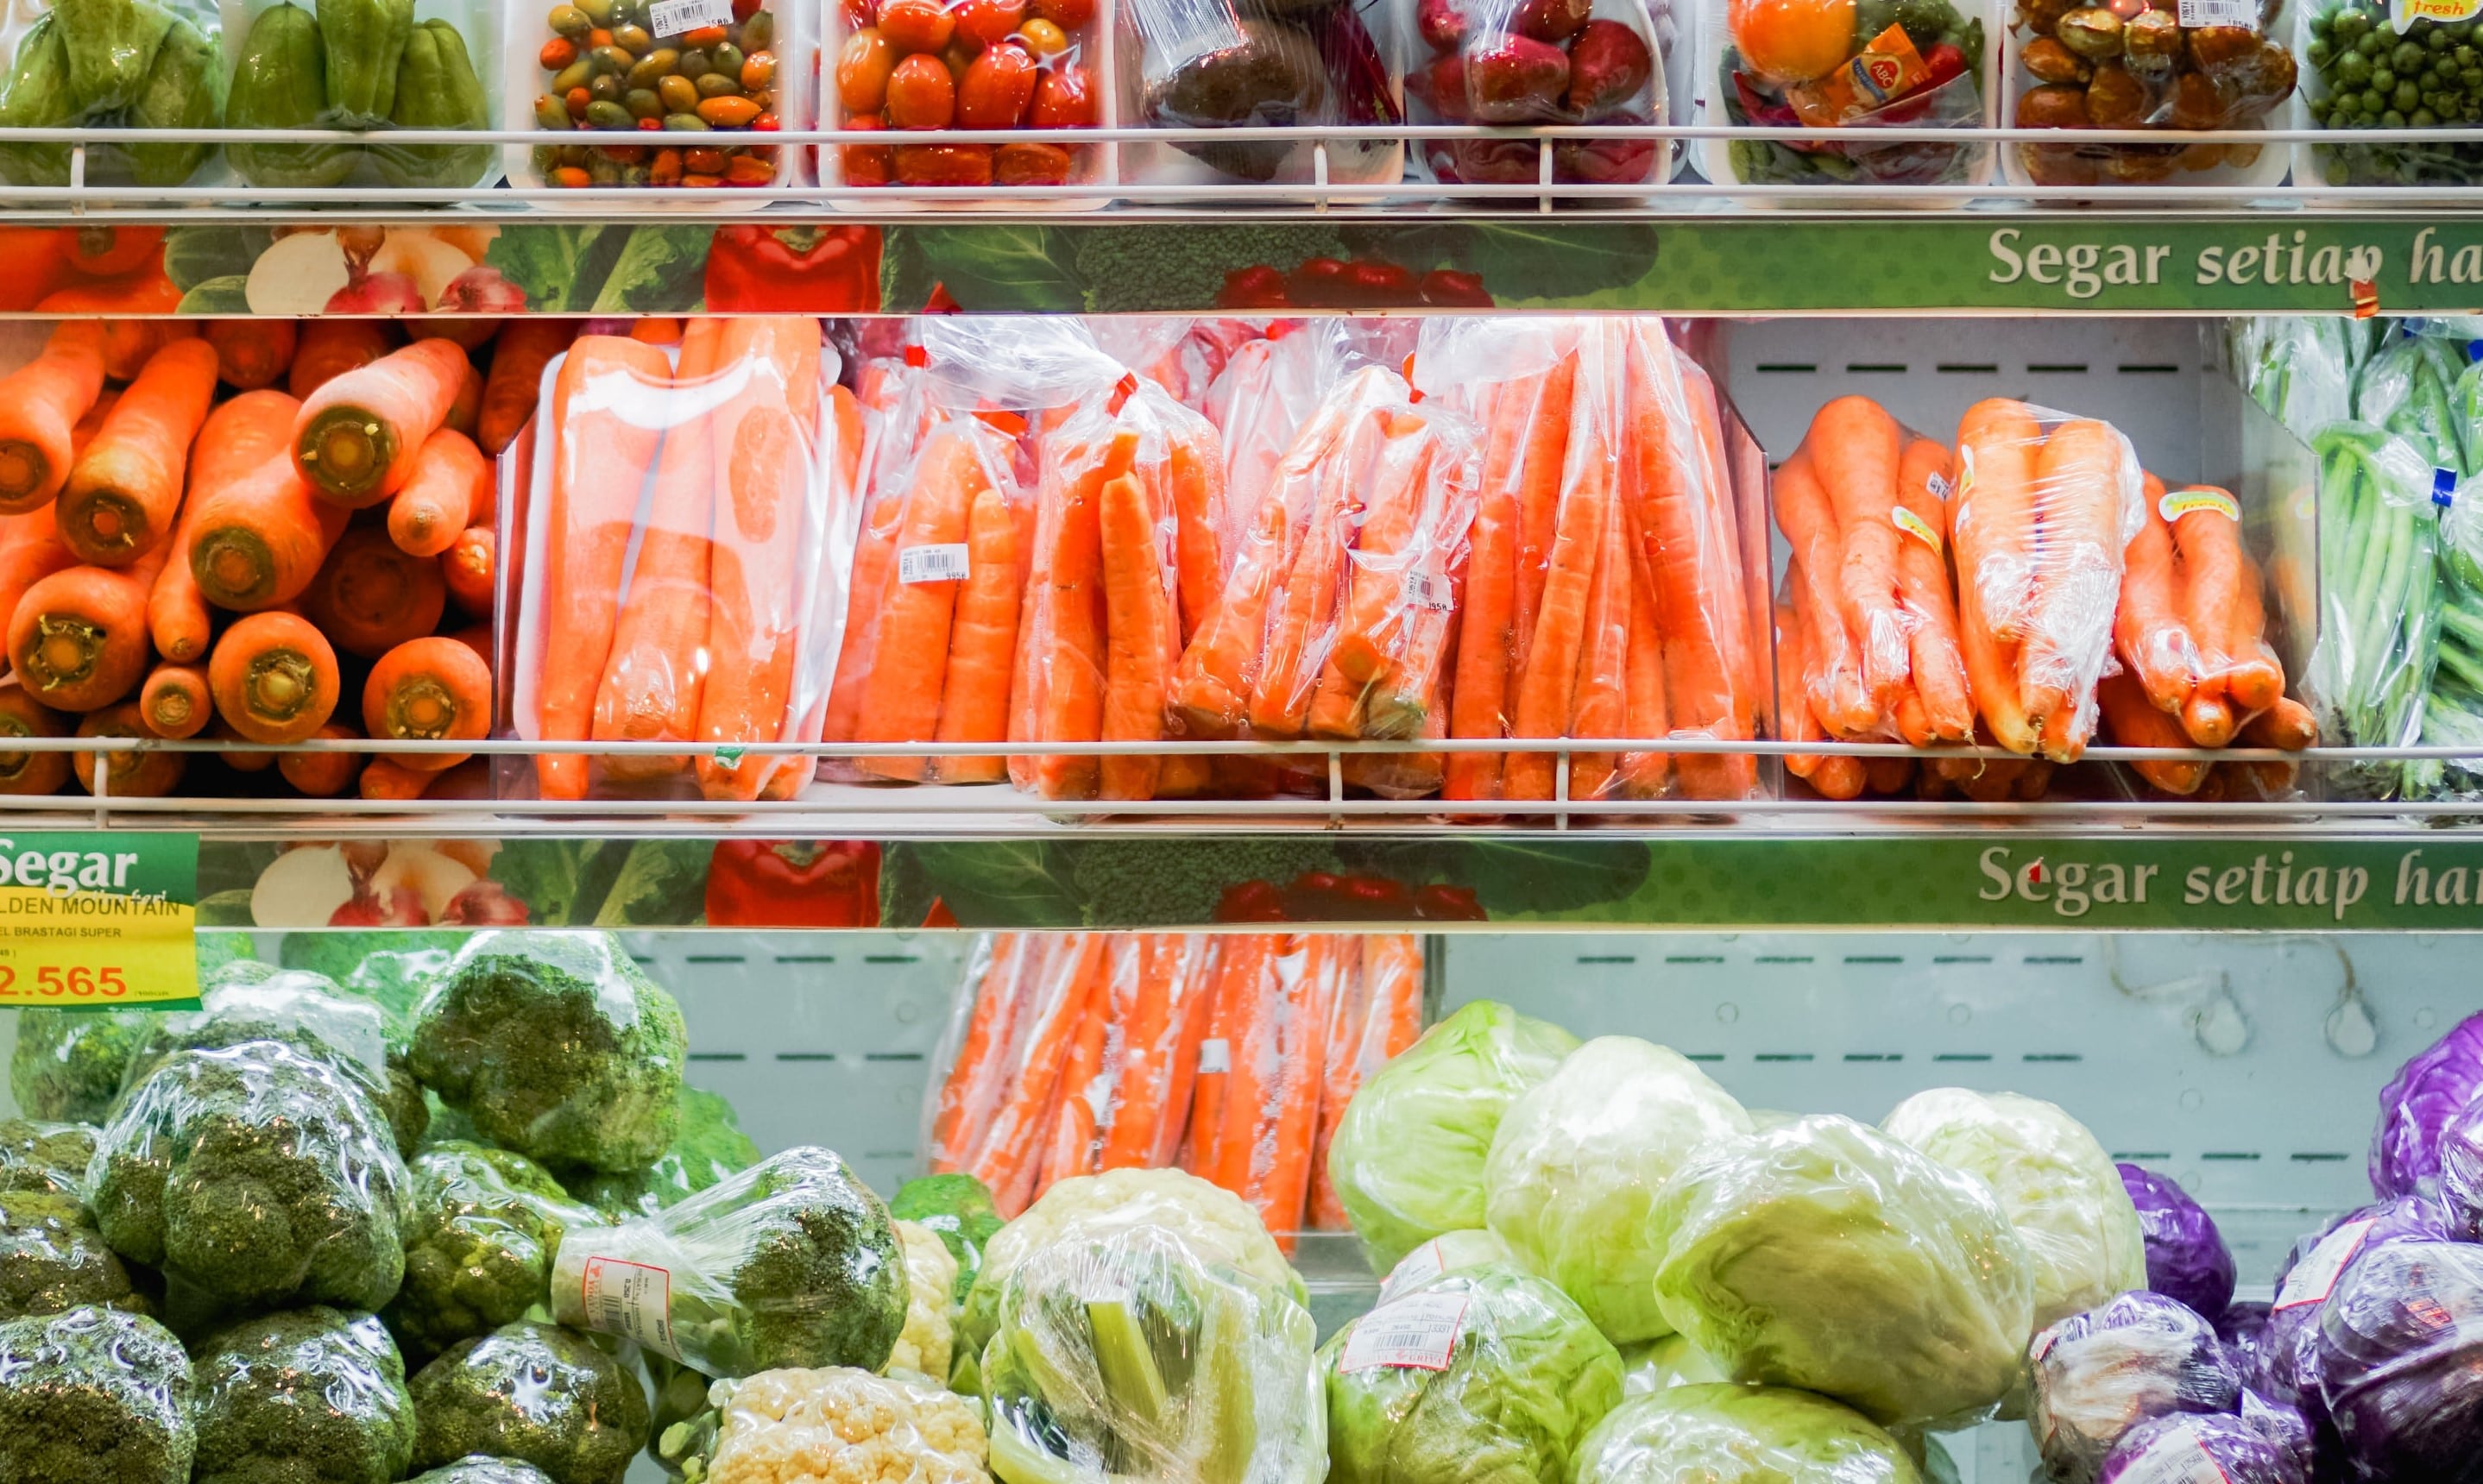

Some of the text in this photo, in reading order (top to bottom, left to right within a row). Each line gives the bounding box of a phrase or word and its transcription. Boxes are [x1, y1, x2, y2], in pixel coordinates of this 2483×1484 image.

[2413, 0, 2465, 15] fresh
[1872, 64, 1894, 87] ABC
[1988, 226, 2483, 299] Segar setiap ha
[1979, 846, 2158, 916] Segar
[2184, 851, 2369, 921] setiap
[60, 897, 180, 916] MOUNTAIN
[14, 926, 77, 938] BRASTAGI
[80, 928, 122, 939] SUPER
[0, 965, 127, 997] 2.565
